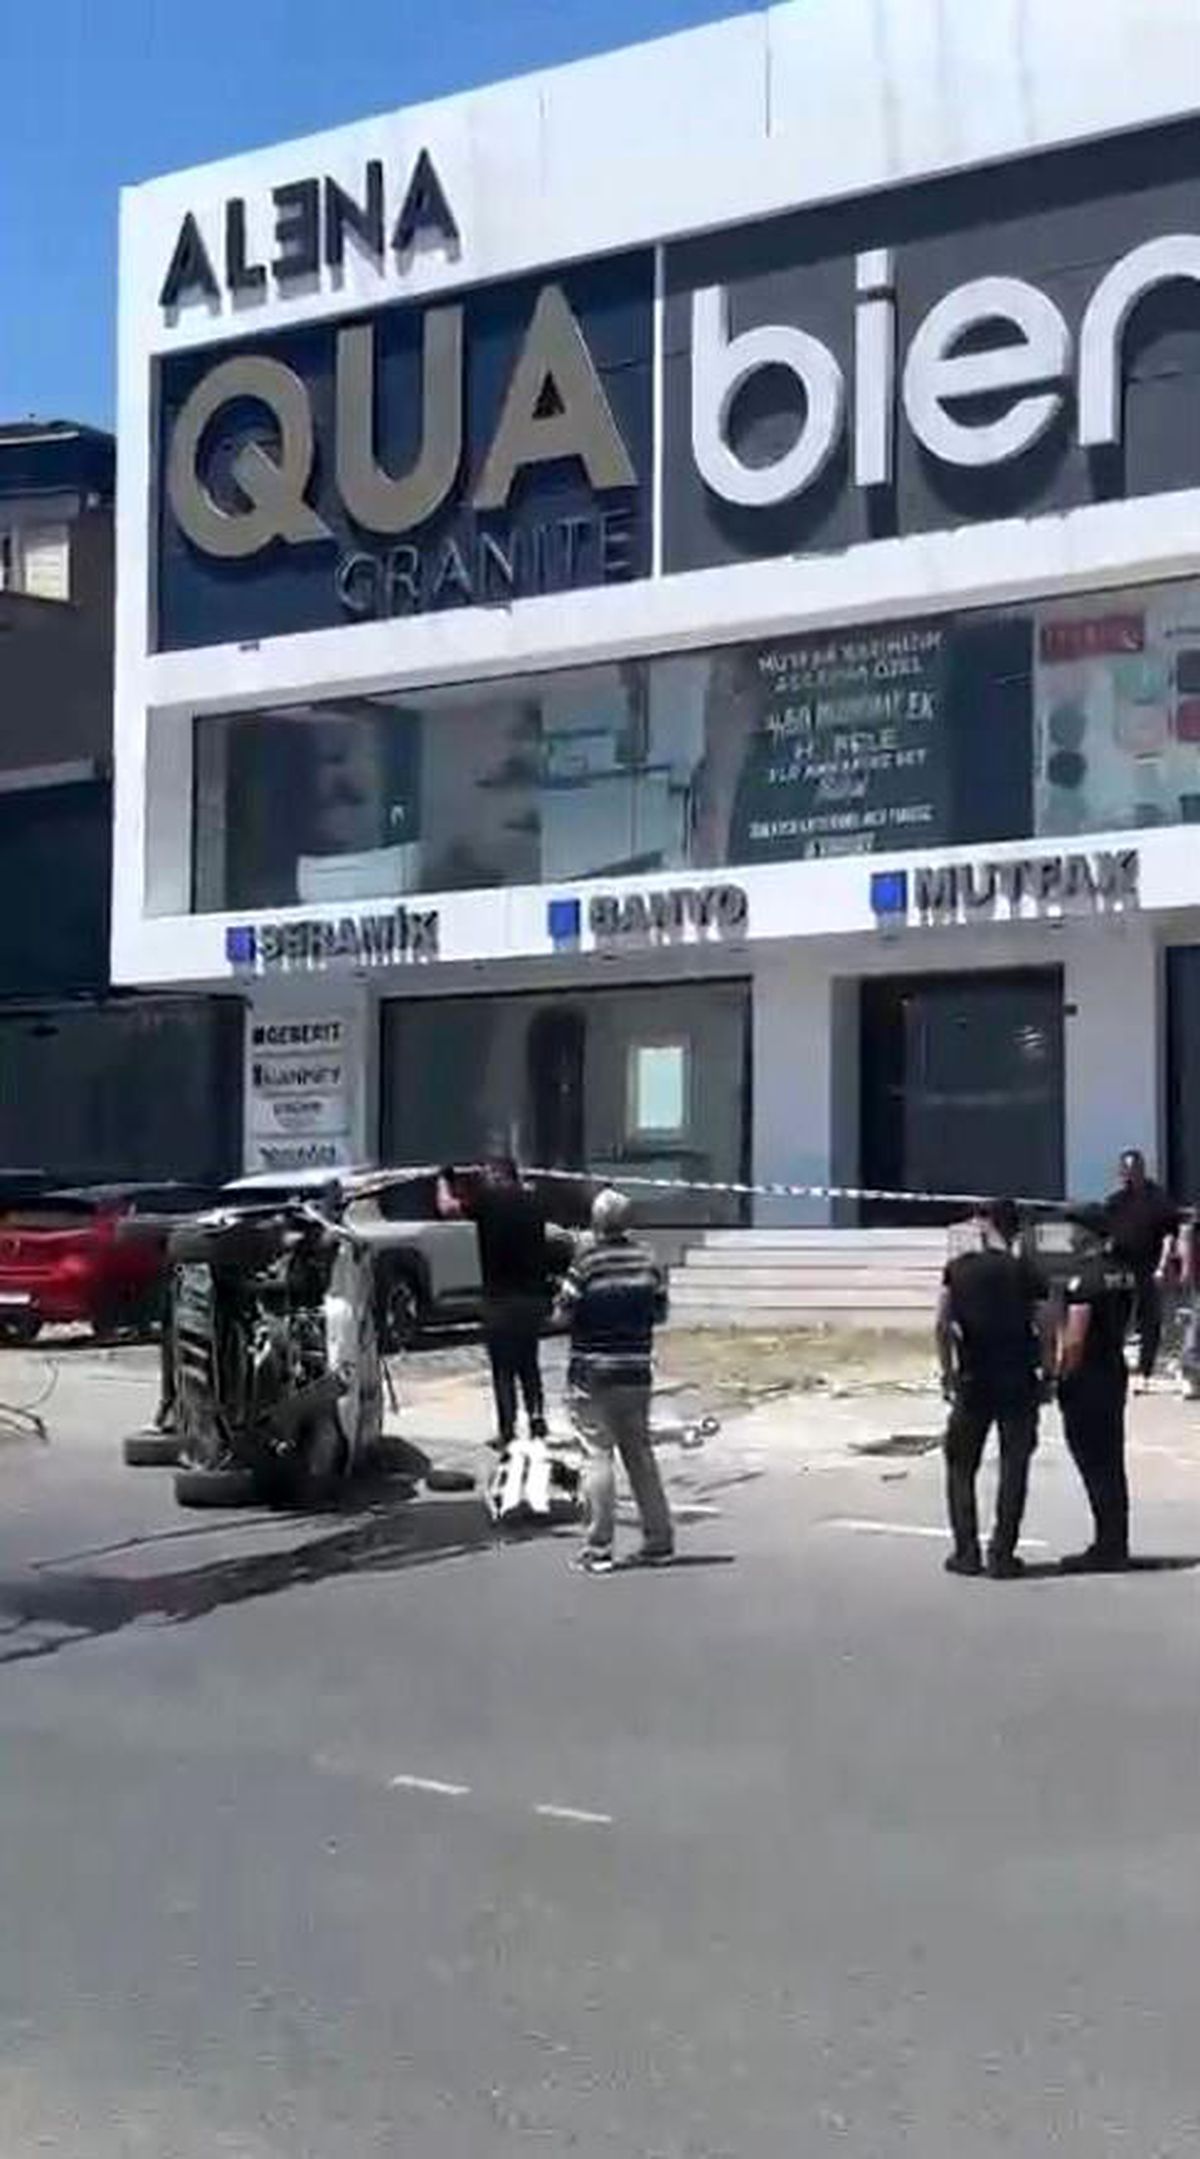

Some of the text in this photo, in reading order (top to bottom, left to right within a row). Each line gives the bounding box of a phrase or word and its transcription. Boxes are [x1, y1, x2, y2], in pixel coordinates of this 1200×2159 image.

[158, 148, 462, 310] ALENA
[168, 284, 638, 558] QUA
[334, 508, 632, 613] GRANITE
[590, 884, 748, 934] BANYO
[915, 848, 1139, 910] MUTFAK
[258, 905, 438, 961] SERAMİK
